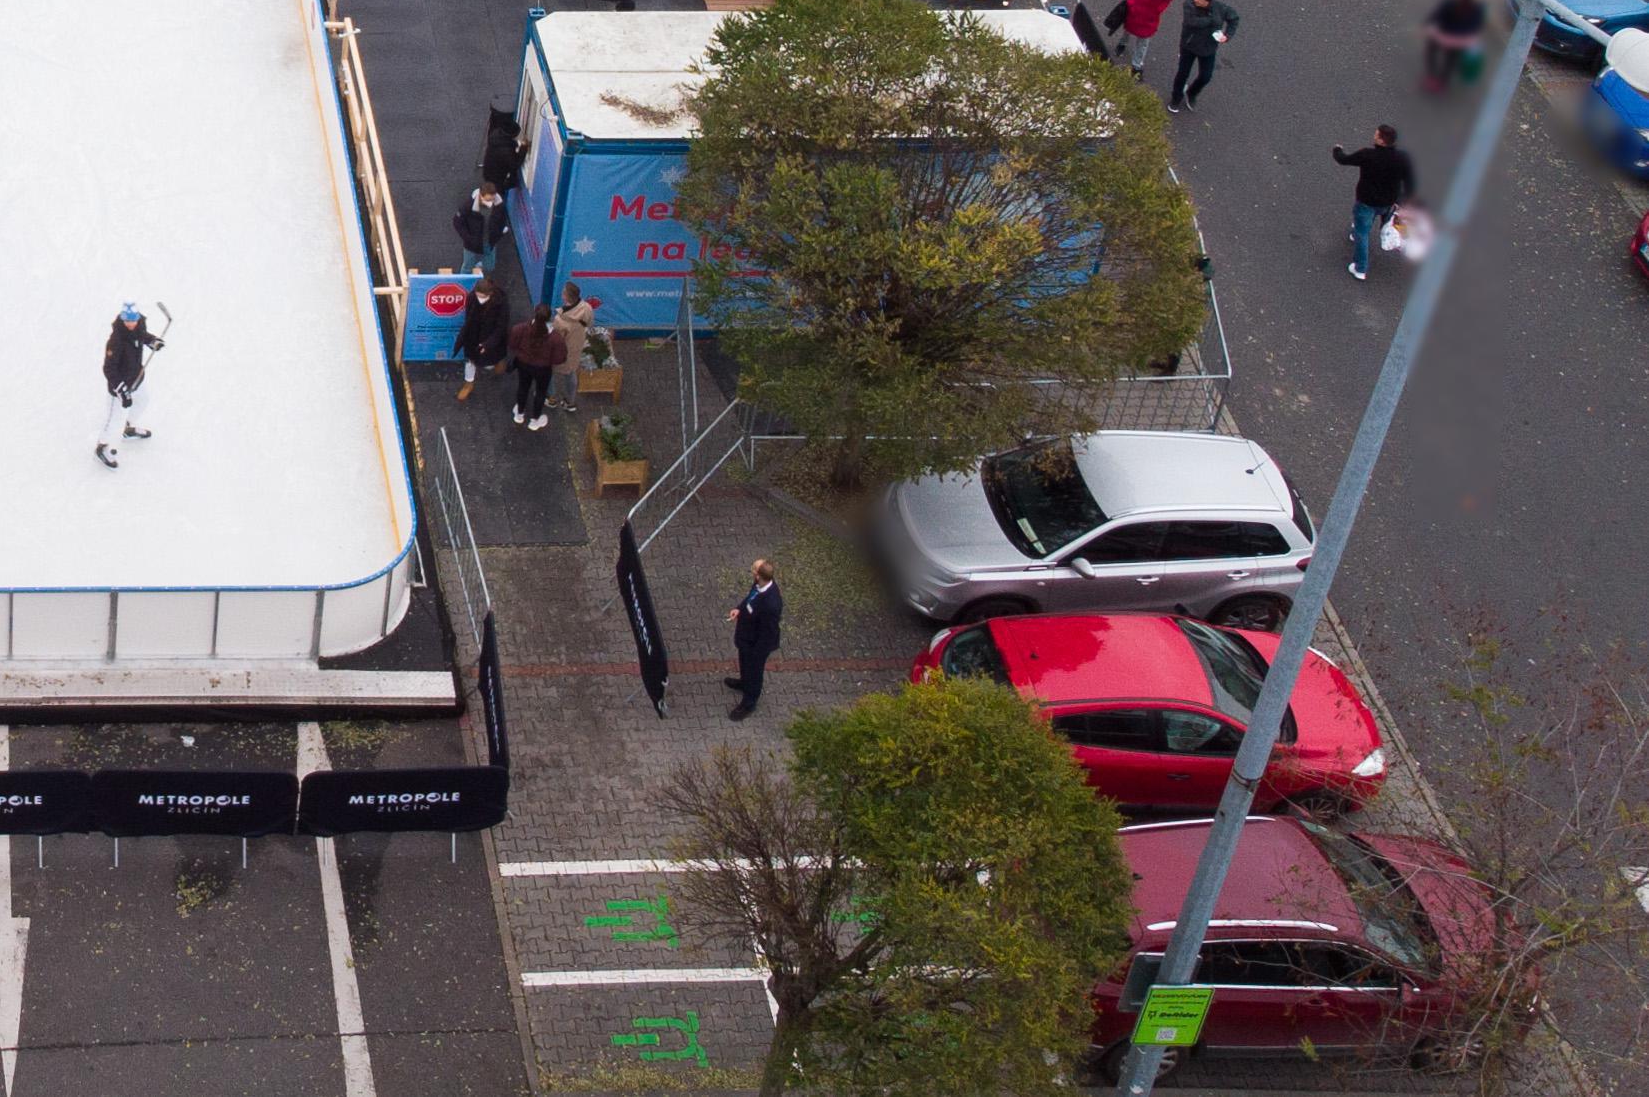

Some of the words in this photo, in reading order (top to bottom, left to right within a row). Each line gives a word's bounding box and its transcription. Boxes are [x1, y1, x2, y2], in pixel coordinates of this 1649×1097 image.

[637, 241, 688, 261] na
[430, 294, 464, 304] STOP
[139, 794, 251, 806] METROPOLE
[349, 791, 461, 804] METROPOLE
